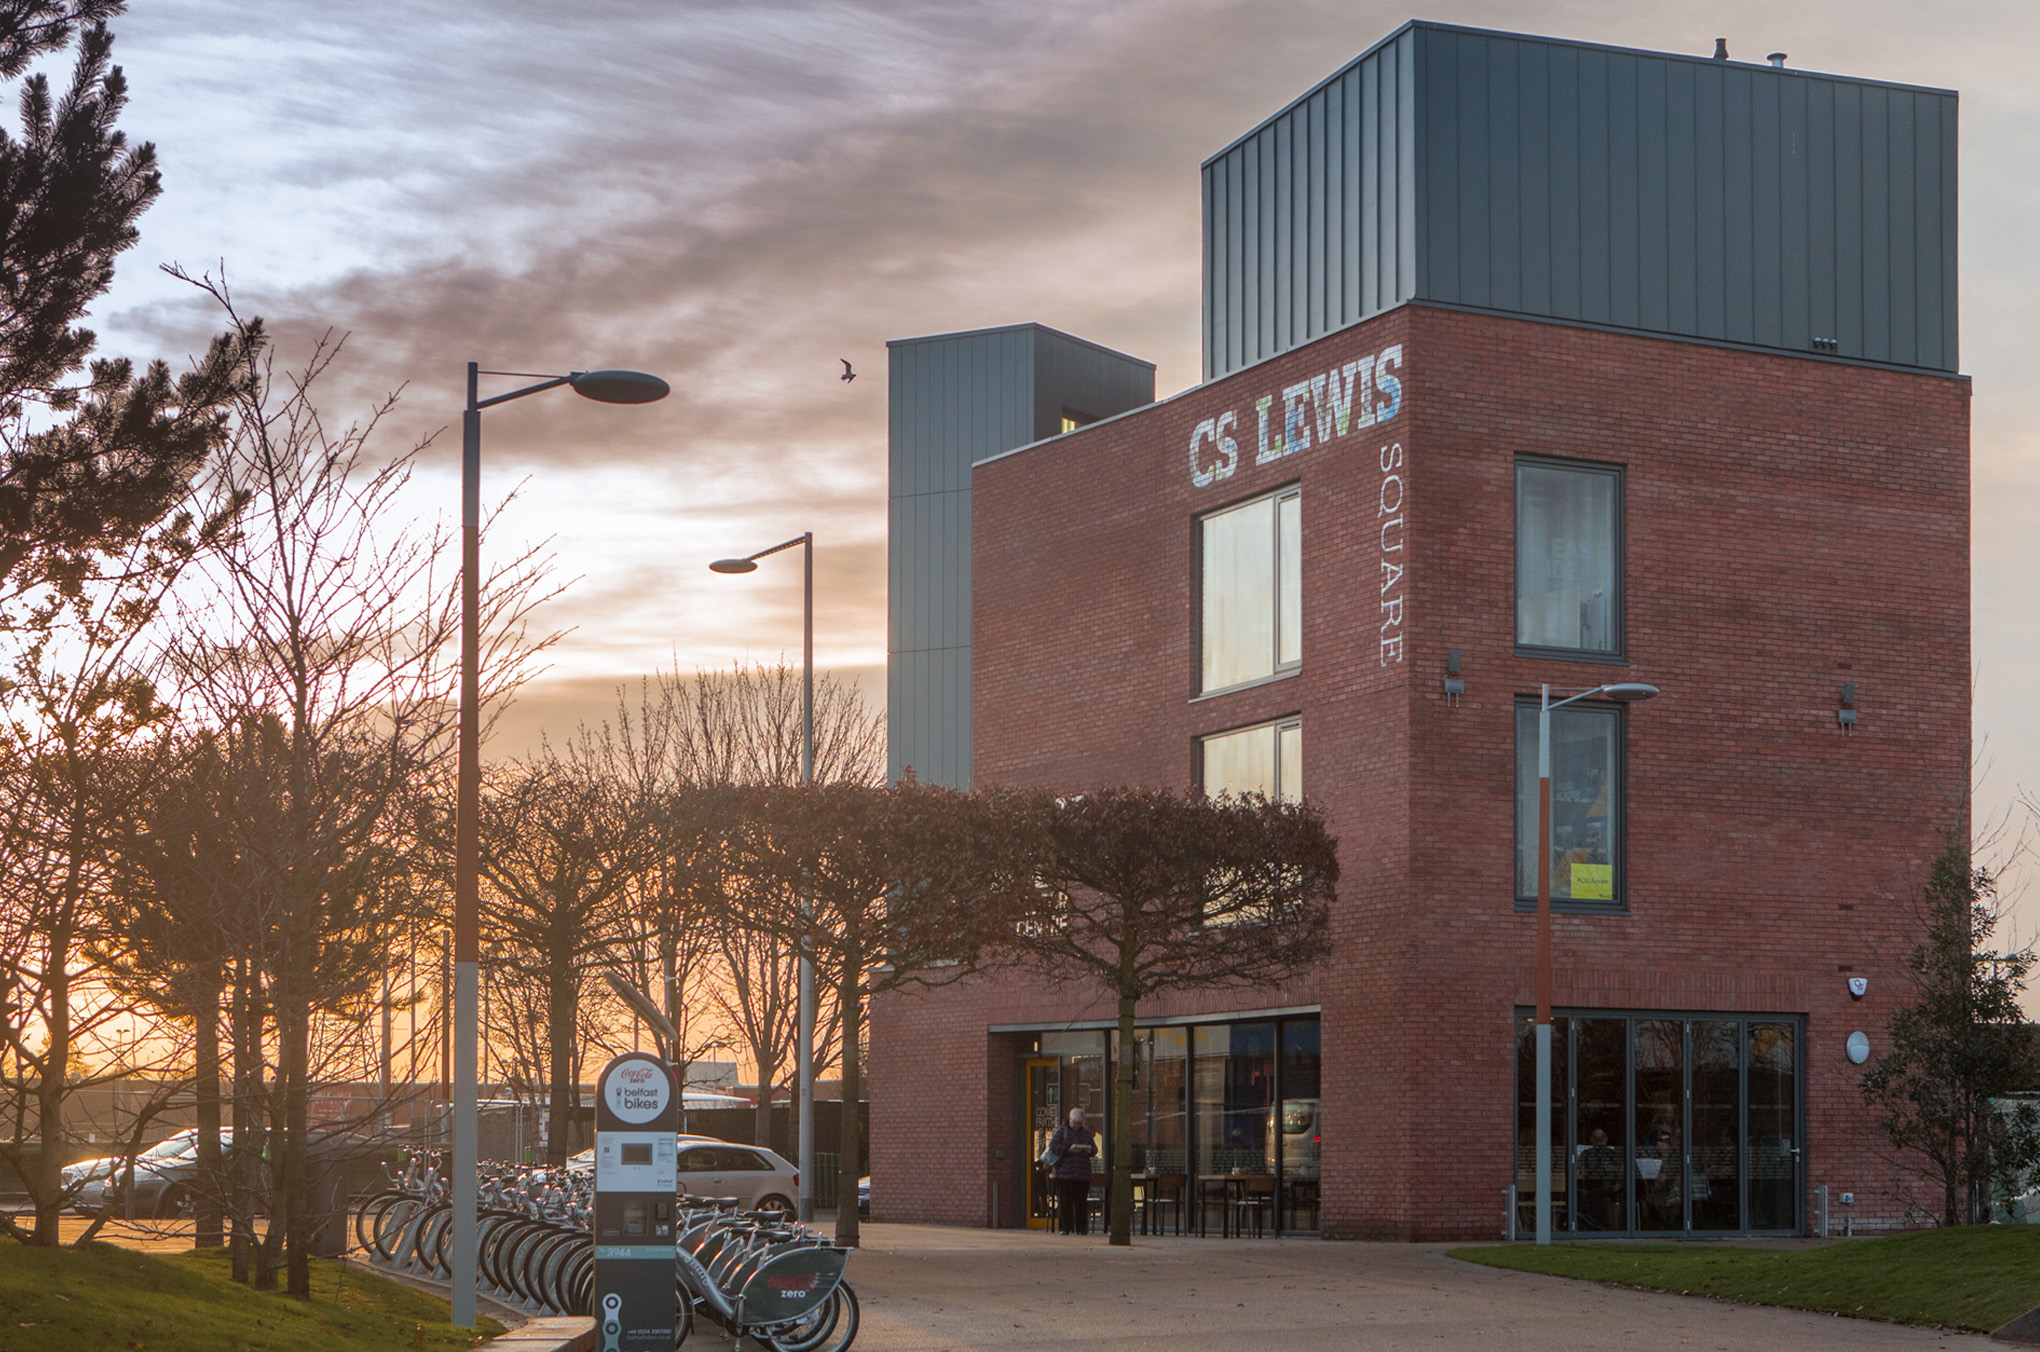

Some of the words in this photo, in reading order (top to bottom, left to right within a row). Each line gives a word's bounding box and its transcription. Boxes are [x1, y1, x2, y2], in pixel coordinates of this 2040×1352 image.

[1189, 409, 1239, 488] CS
[1255, 343, 1403, 466] LEWIS
[1377, 442, 1404, 667] SQUARE
[624, 1087, 658, 1097] belfast
[624, 1097, 658, 1109] bikes
[607, 1248, 632, 1257] 3944
[780, 1290, 806, 1298] zero
